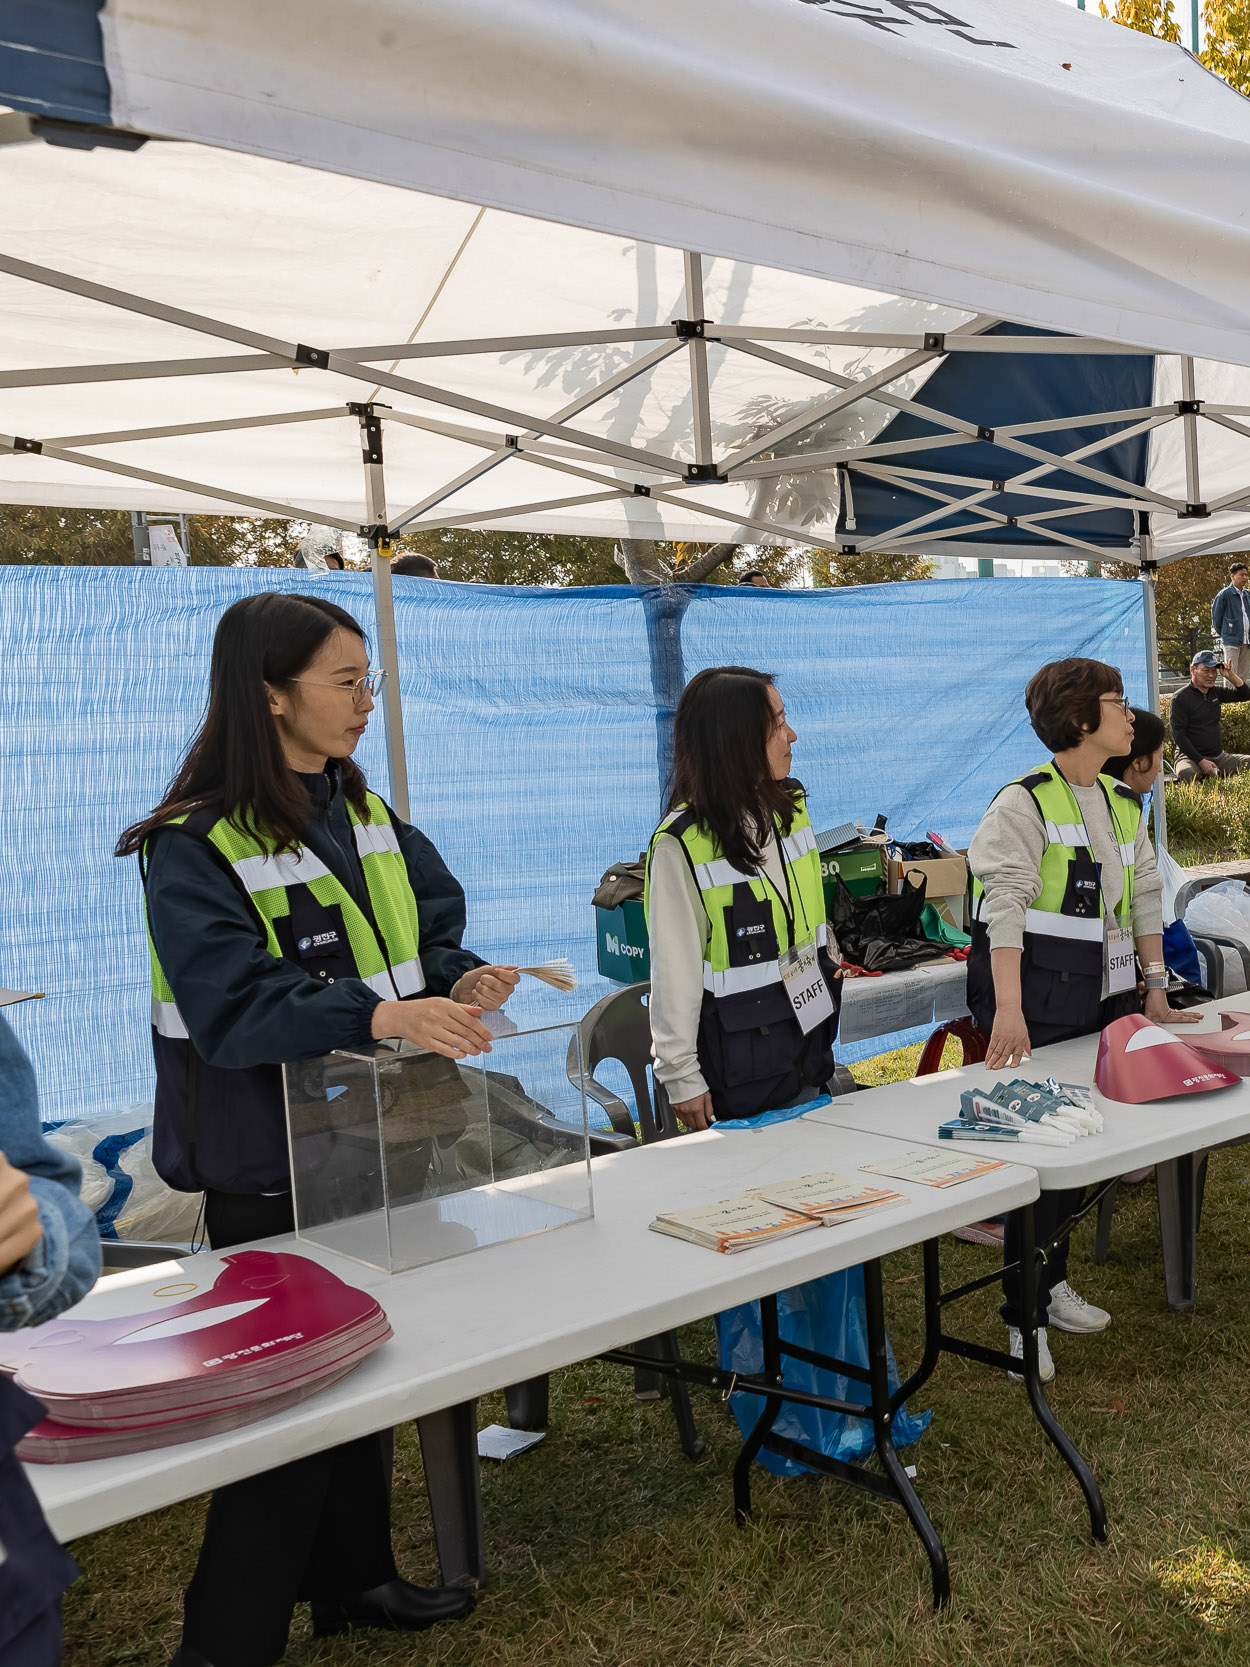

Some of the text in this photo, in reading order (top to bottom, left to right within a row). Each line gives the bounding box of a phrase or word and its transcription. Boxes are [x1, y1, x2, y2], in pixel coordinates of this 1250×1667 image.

[312, 931, 337, 943] 광진구
[620, 943, 644, 959] COPY
[1109, 953, 1134, 971] STAFF
[792, 978, 824, 1010] STAFF
